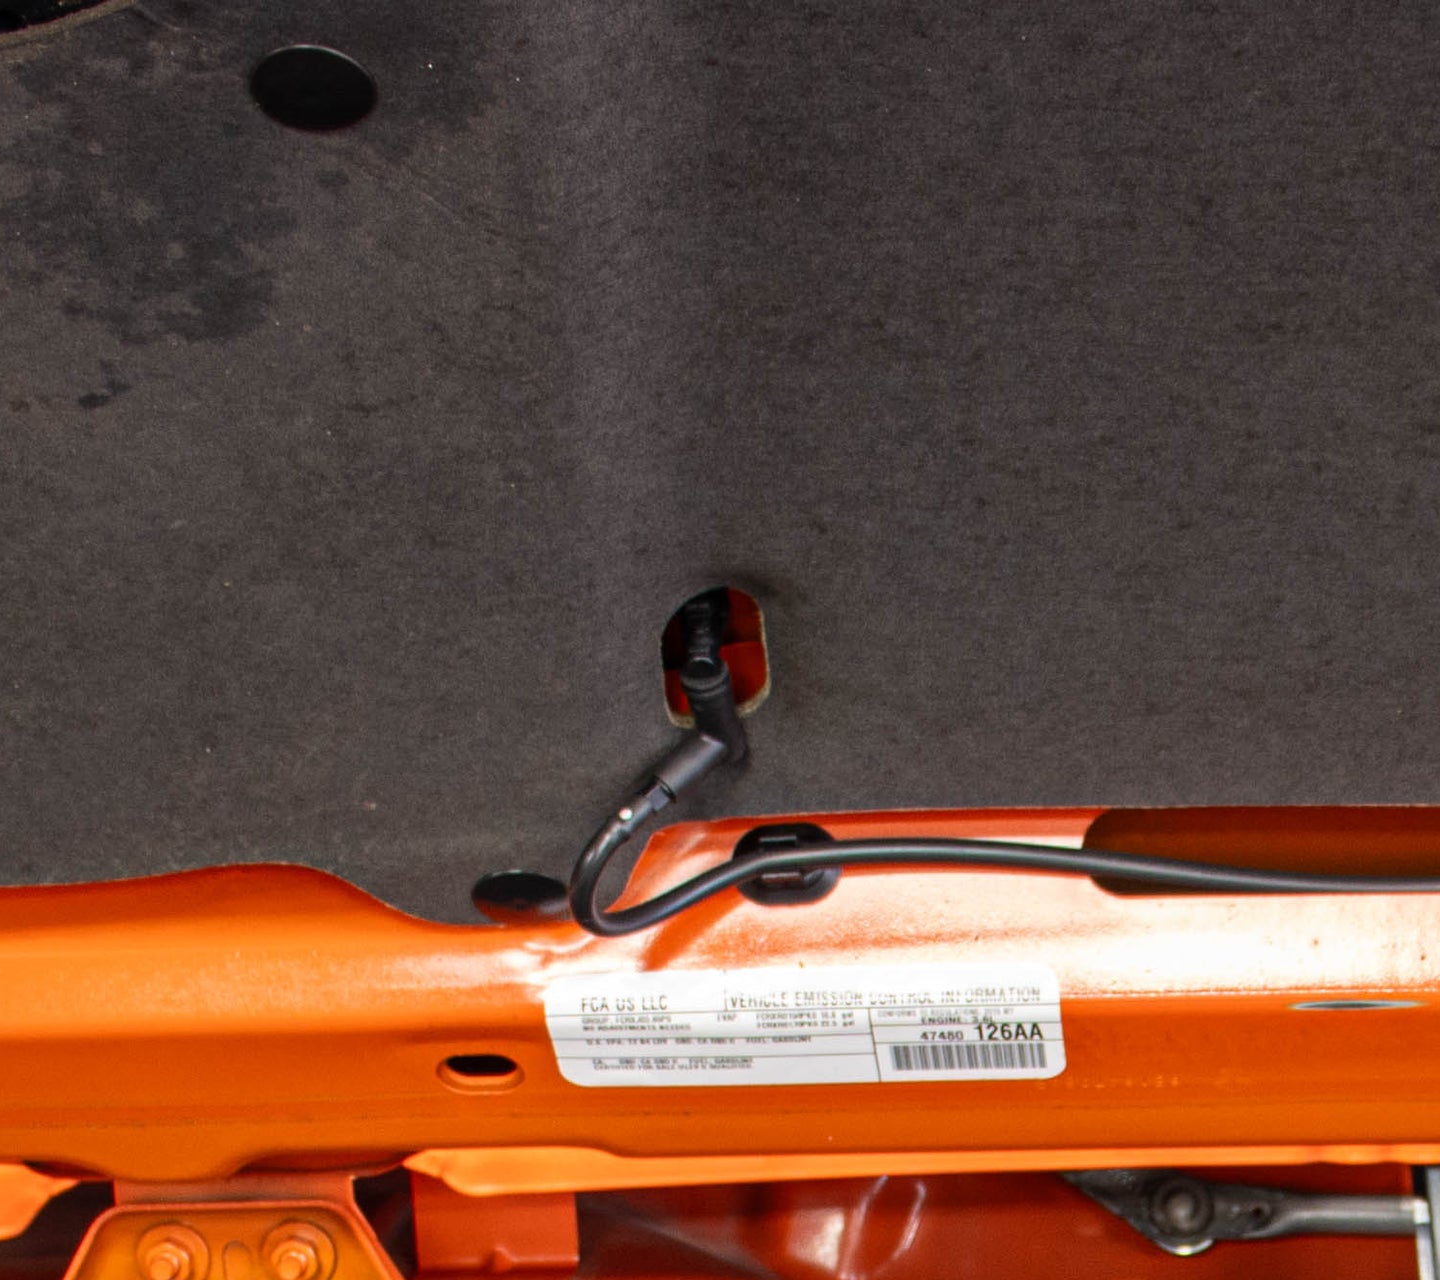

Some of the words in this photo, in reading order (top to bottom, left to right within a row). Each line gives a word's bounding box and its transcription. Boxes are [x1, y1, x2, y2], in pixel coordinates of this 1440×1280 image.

[581, 996, 609, 1013] FCA
[642, 994, 668, 1011] LLC
[974, 1022, 1044, 1041] 126AA
